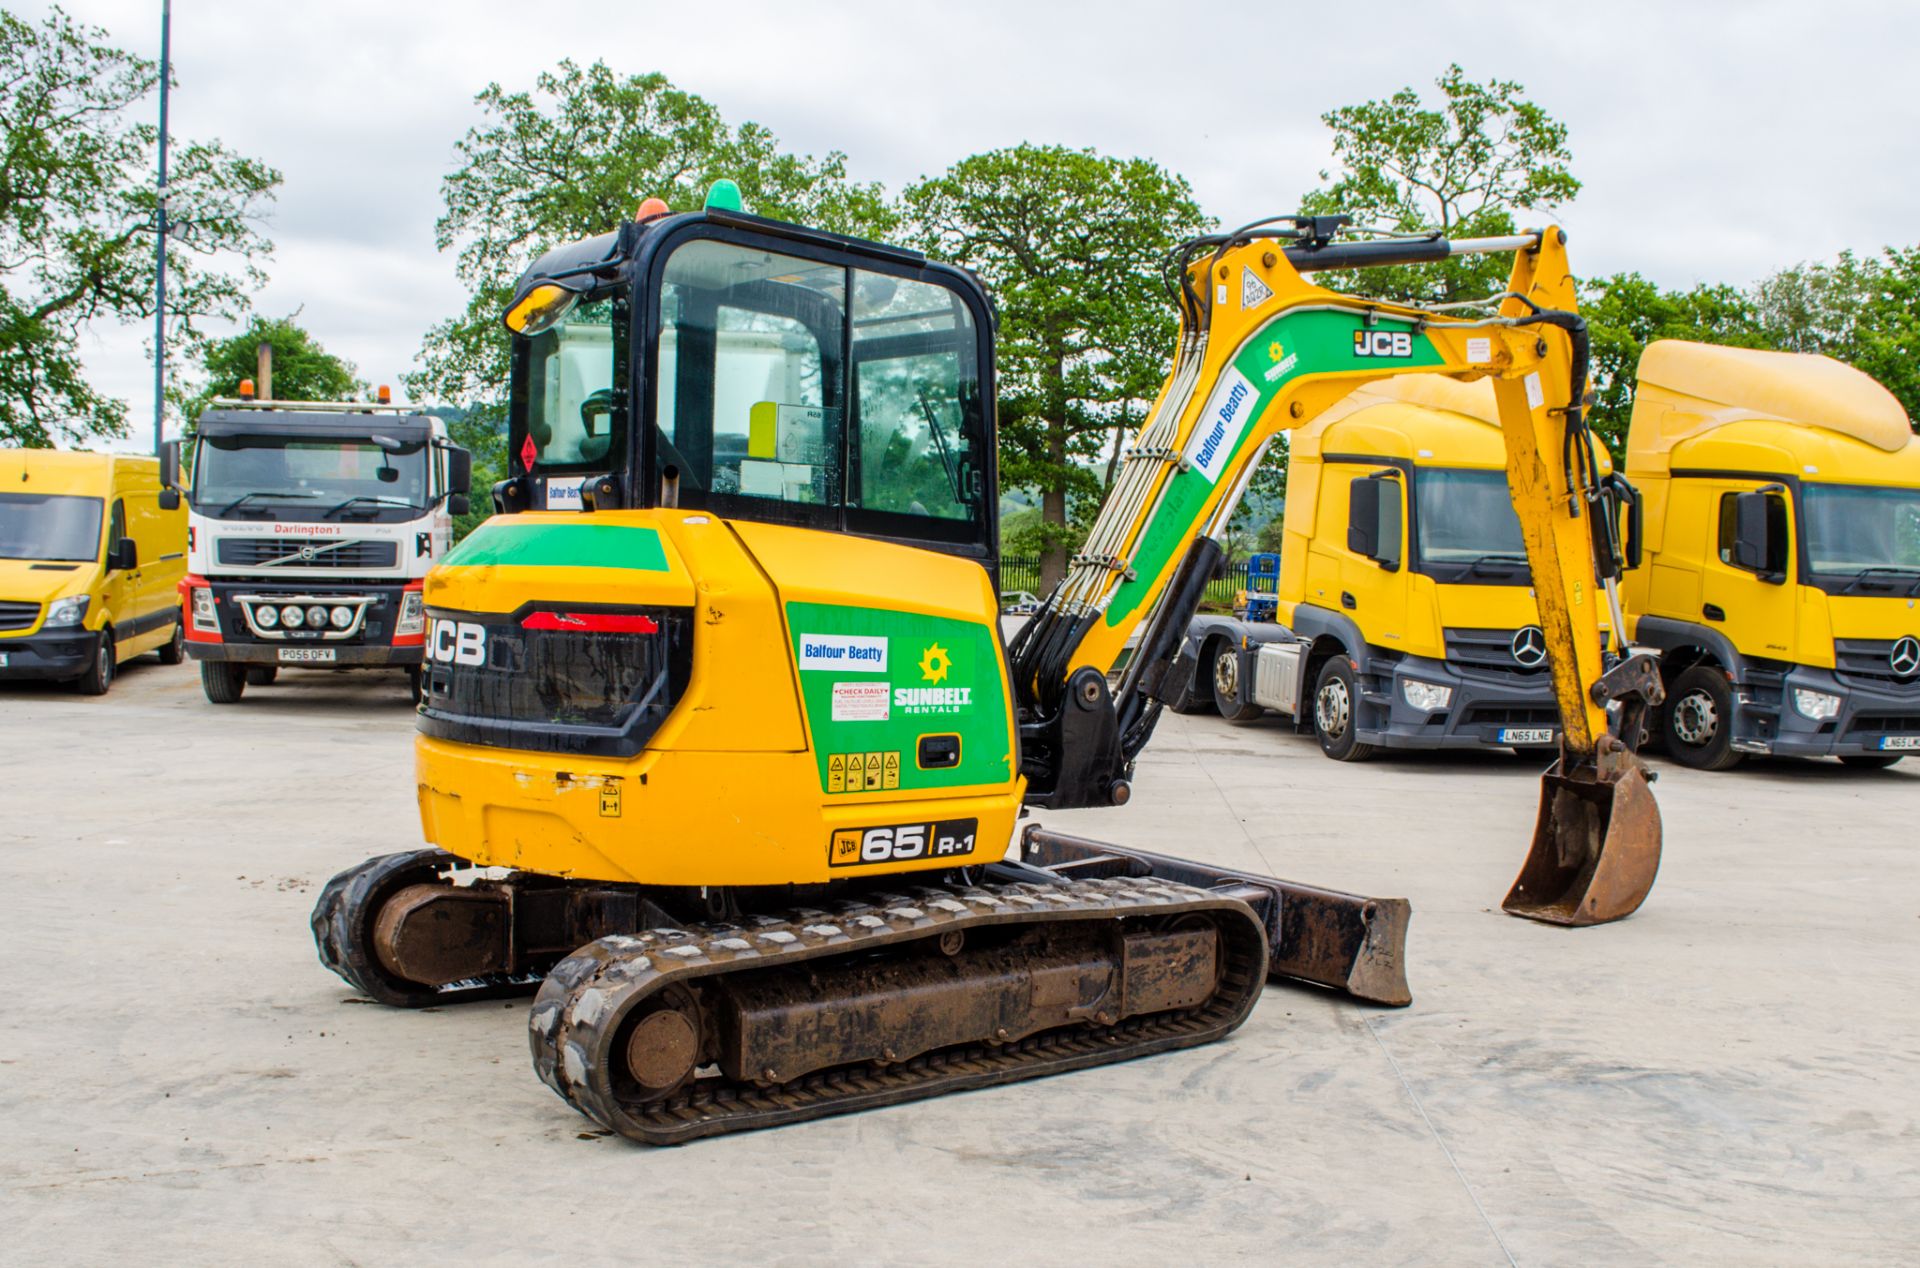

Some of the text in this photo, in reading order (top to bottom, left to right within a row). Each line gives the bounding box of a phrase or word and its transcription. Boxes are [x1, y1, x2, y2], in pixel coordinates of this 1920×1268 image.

[1355, 331, 1412, 356] JCB
[1195, 380, 1249, 469] Balfour Beatty
[274, 524, 341, 536] Darlington's
[425, 617, 486, 666] JCB
[282, 649, 309, 659] PO56
[805, 643, 883, 663] Balfour Beatty
[894, 688, 972, 706] SUNBELT
[904, 706, 961, 714] RENTALS
[1505, 730, 1550, 741] LN65 LNE
[840, 838, 857, 855] JCB
[861, 825, 975, 862] 65 R-1
